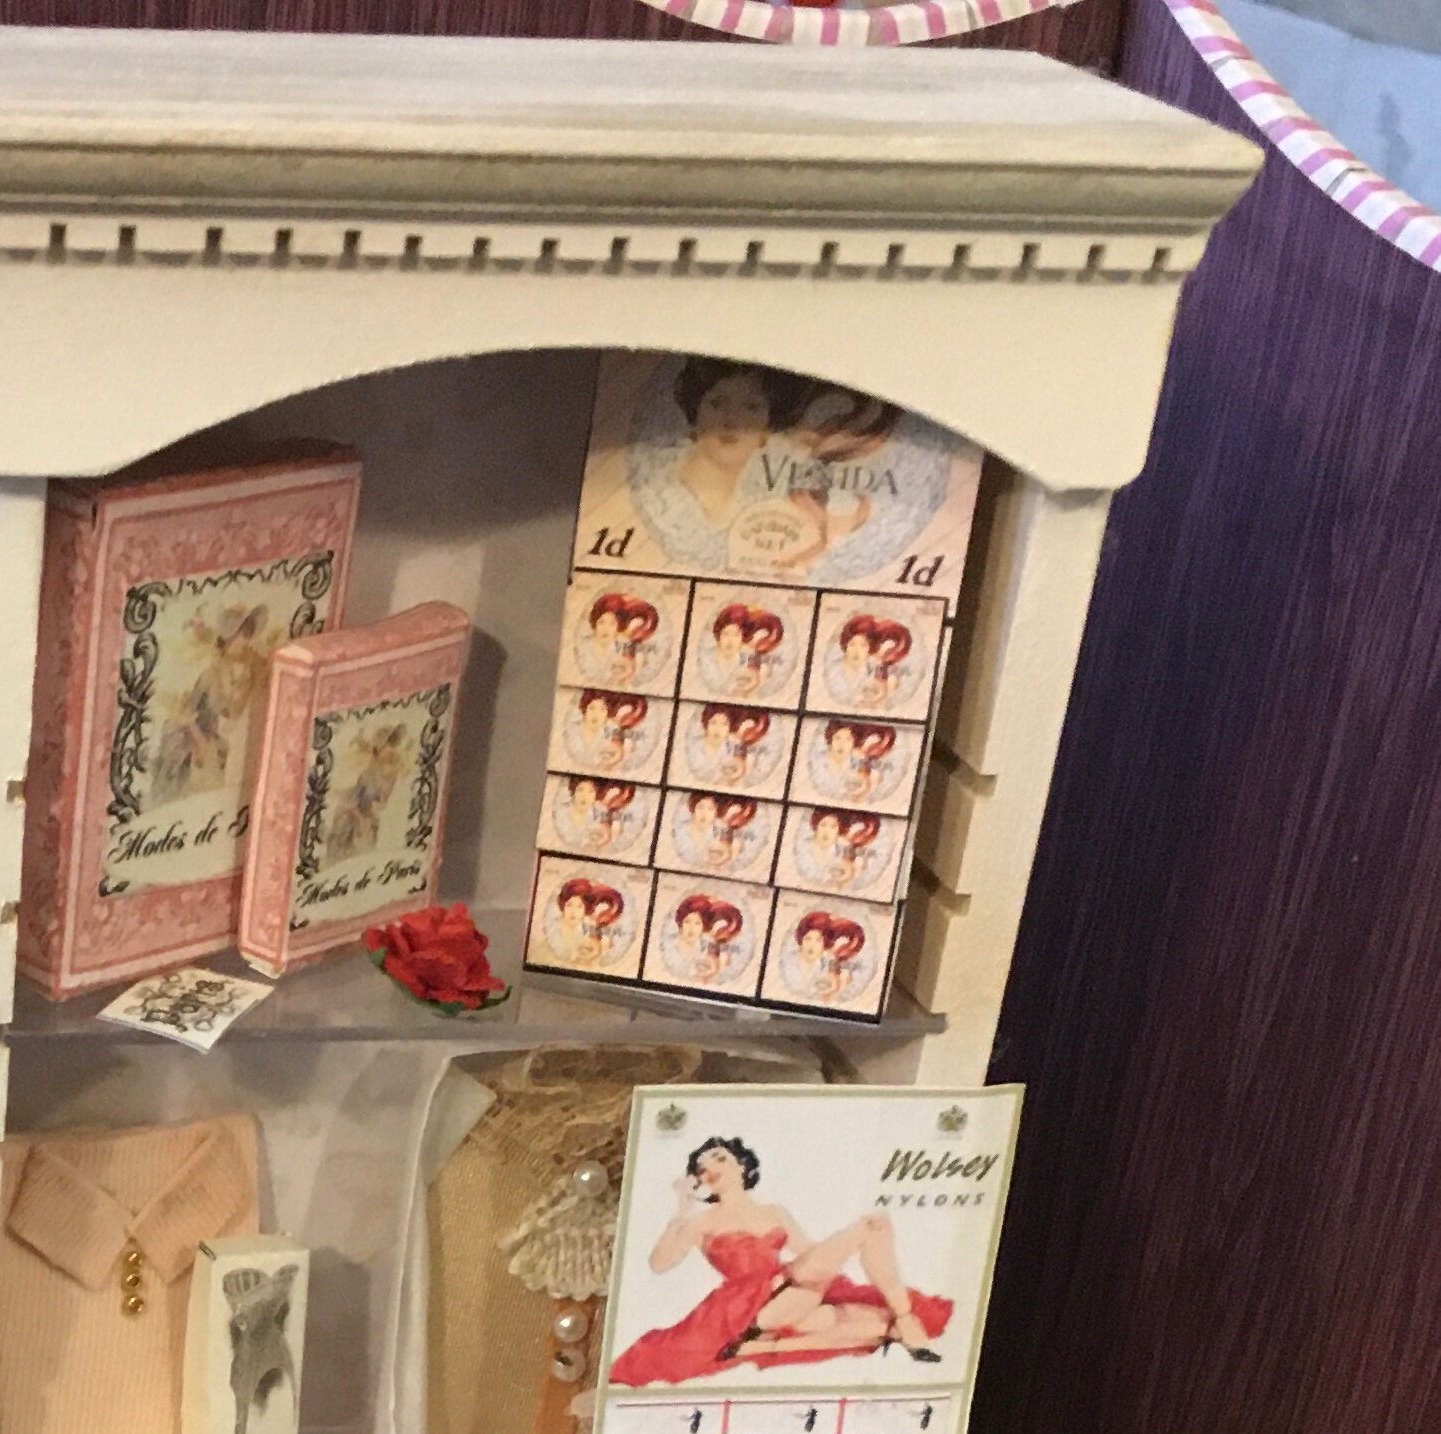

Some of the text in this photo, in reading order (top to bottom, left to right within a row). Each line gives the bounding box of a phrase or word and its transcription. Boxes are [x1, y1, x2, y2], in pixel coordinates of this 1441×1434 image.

[587, 526, 635, 558] 1d
[895, 554, 945, 587] 1d
[107, 821, 187, 864] Modes
[194, 811, 223, 846] de
[354, 866, 376, 891] de
[880, 1148, 1000, 1182] Wolsey
[875, 1192, 985, 1208] NYLONS
